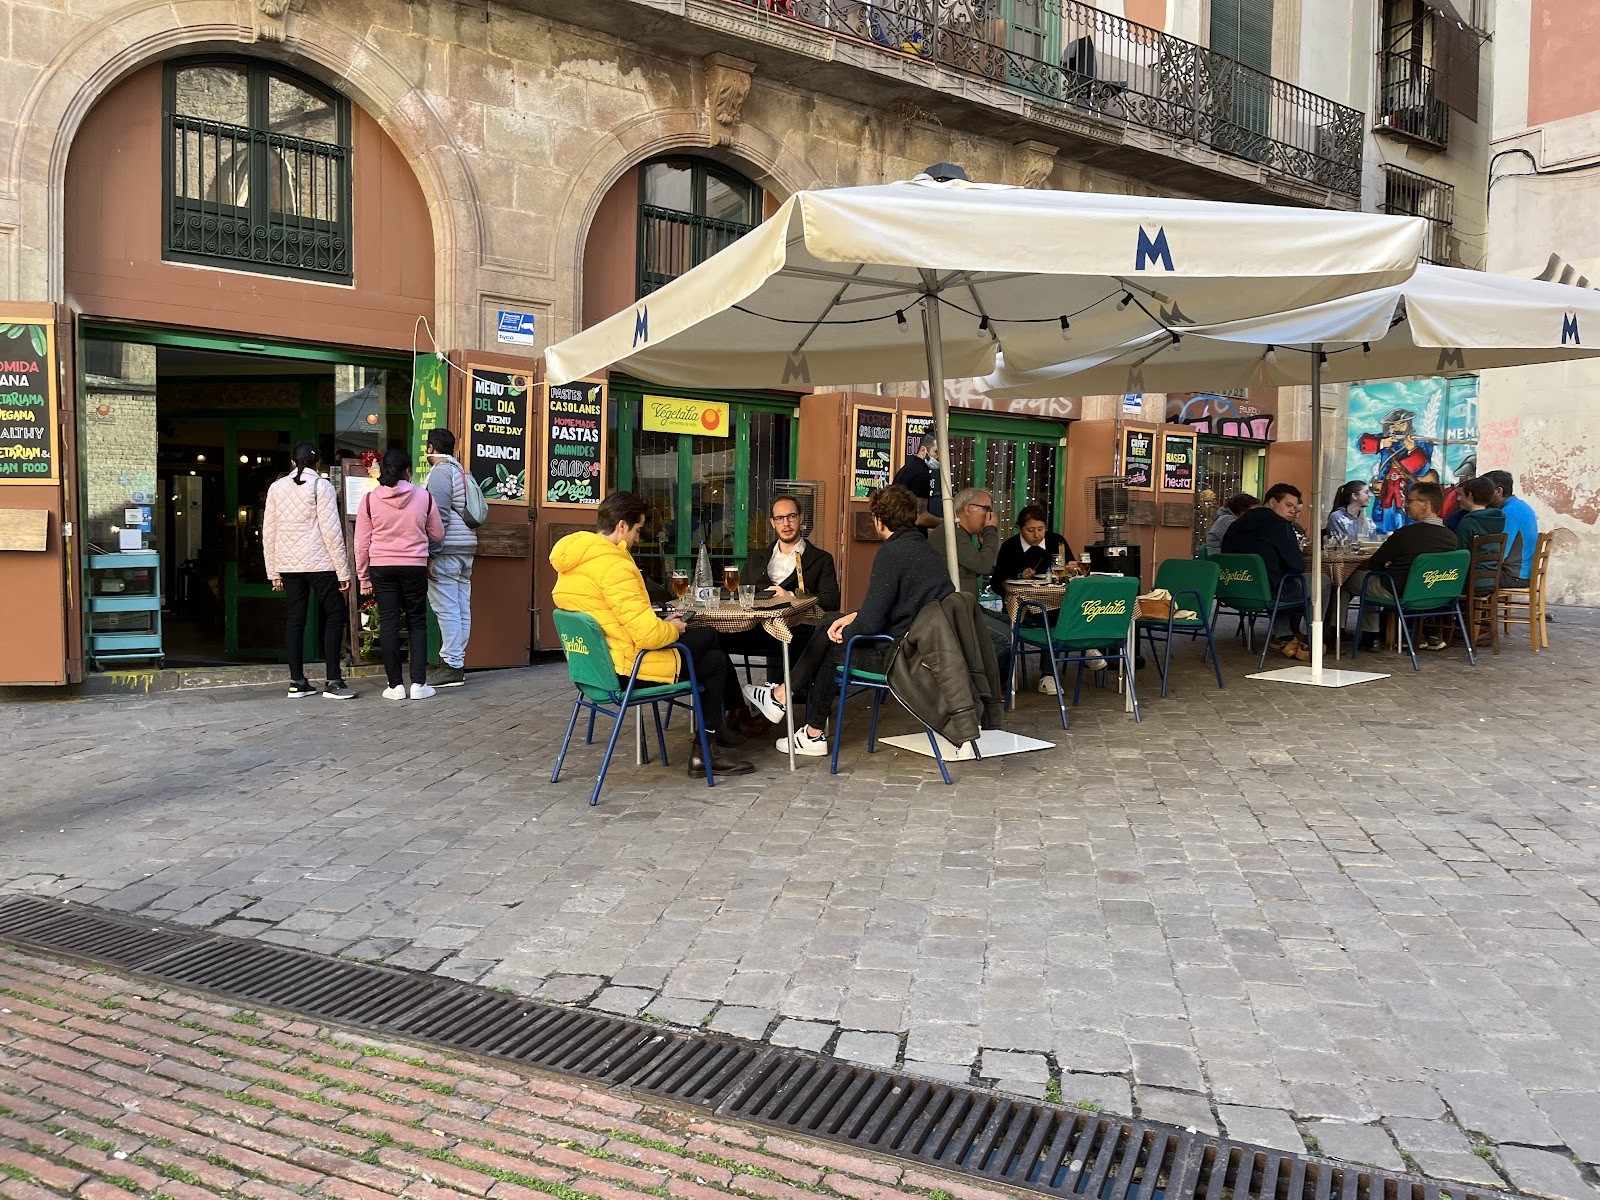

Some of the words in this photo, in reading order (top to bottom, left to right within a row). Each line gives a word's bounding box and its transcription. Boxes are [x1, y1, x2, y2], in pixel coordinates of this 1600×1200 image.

[1135, 224, 1175, 271] M
[632, 304, 649, 348] M
[1561, 312, 1581, 344] M
[475, 380, 505, 396] MENU
[550, 387, 583, 401] PASTES
[474, 398, 494, 412] DEL
[497, 400, 516, 414] DIA
[550, 401, 601, 416] CASOLANES
[486, 415, 512, 425] MENU
[651, 402, 700, 427] Vegetalia
[474, 423, 487, 434] OF
[488, 425, 505, 435] THE
[506, 427, 523, 436] DAY
[554, 416, 597, 429] HOMEMADE
[551, 426, 599, 443] PASTAS
[41, 449, 51, 458] &
[476, 443, 521, 461] BRUNCH
[554, 443, 595, 458] AMANIDES
[859, 448, 874, 458] SWEET
[1132, 447, 1146, 456] BEER
[1166, 453, 1186, 463] BASED
[22, 463, 49, 473] FOOD
[550, 459, 591, 478] SALADS
[867, 459, 884, 469] CAKES
[554, 479, 593, 501] Vegan
[1081, 600, 1126, 622] Vegetalia
